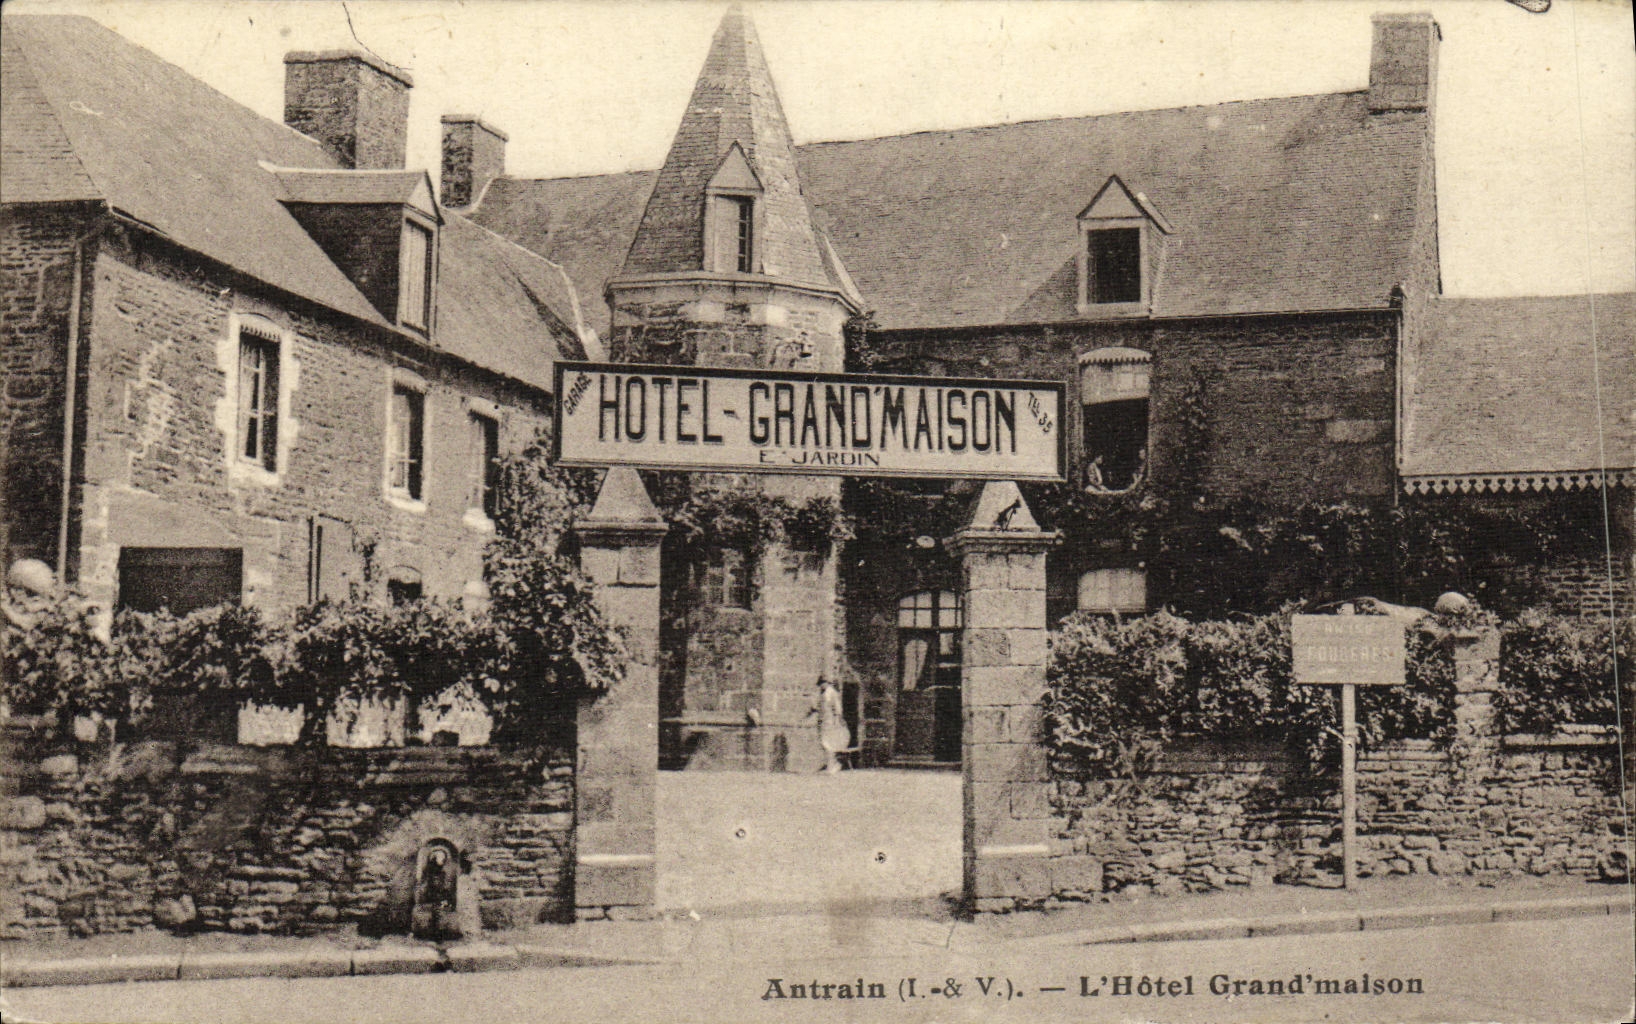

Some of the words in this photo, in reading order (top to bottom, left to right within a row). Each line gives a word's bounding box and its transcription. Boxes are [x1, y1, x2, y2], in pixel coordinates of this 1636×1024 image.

[564, 372, 592, 415] GARAGE
[1038, 412, 1053, 433] 35
[791, 451, 880, 466] JARDIN
